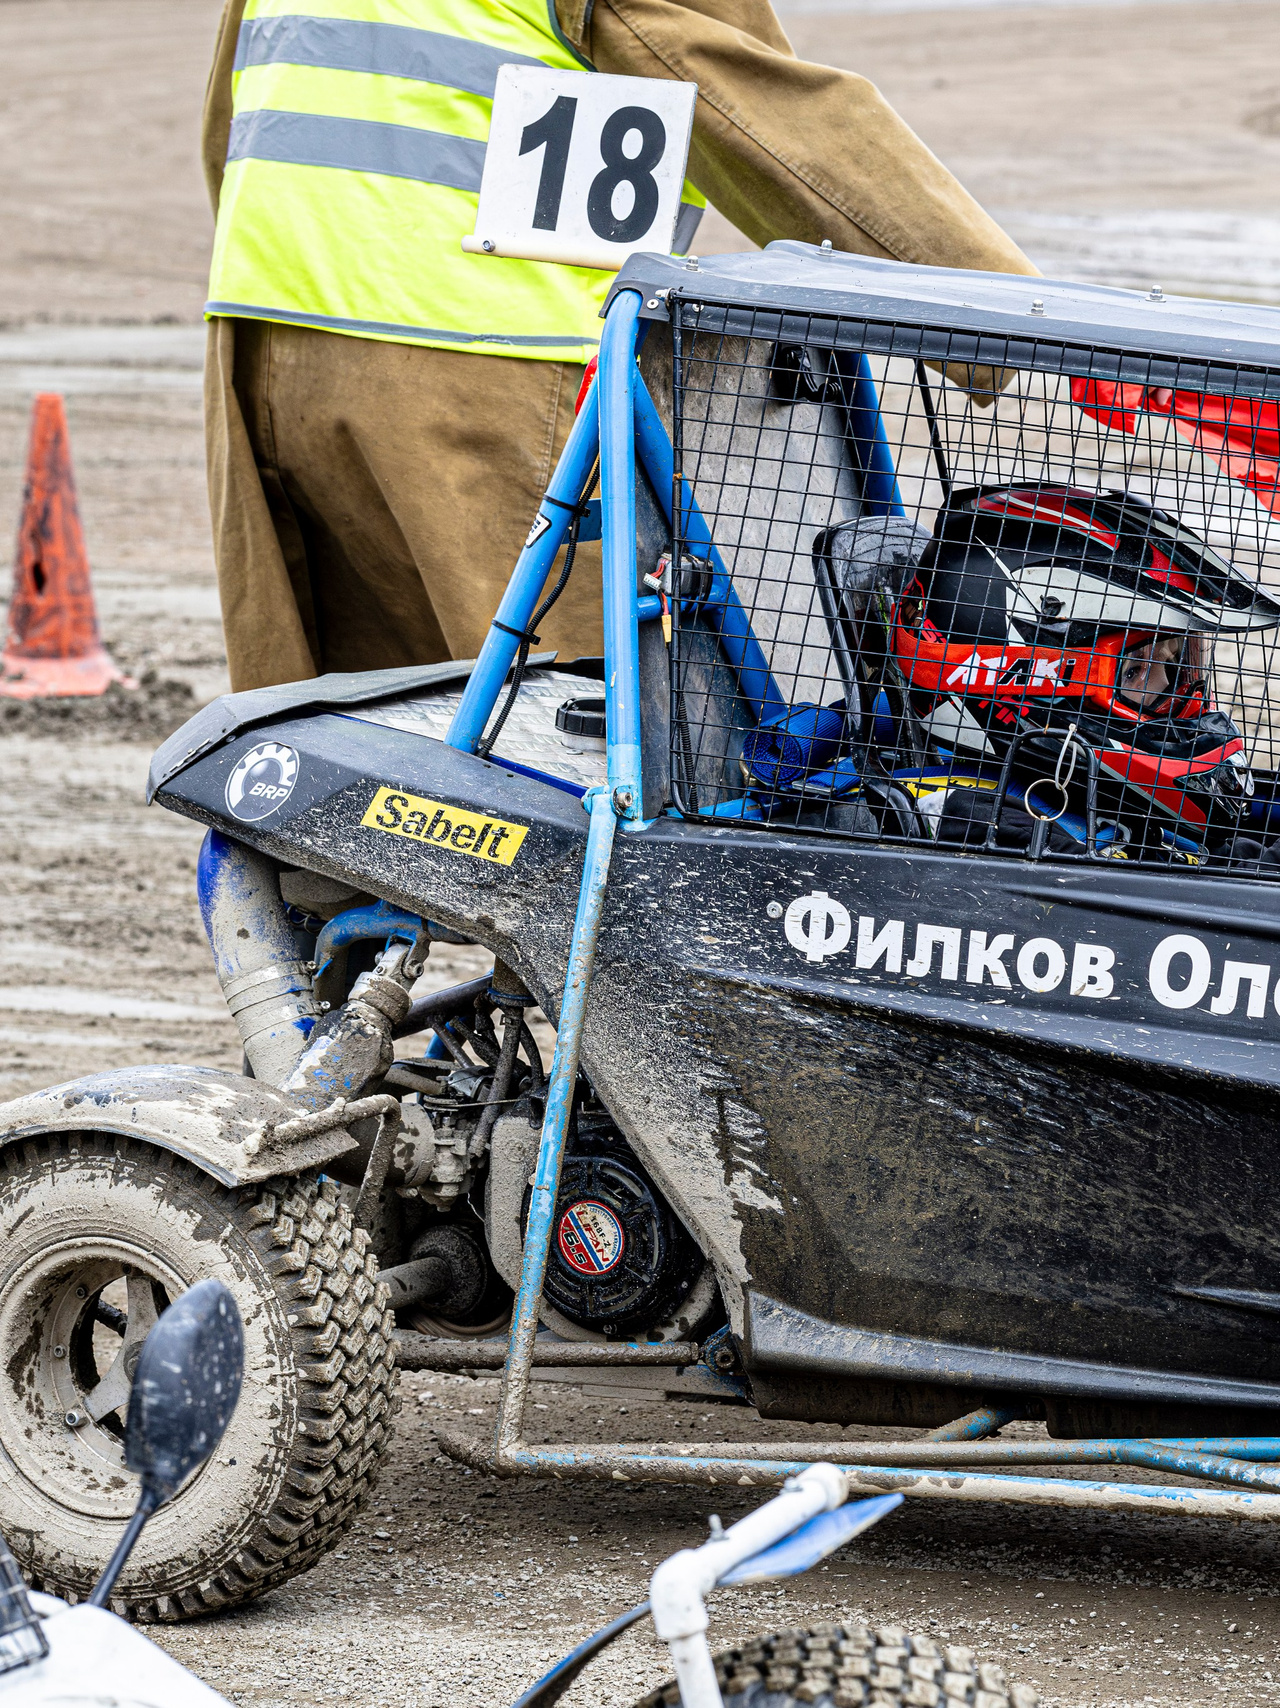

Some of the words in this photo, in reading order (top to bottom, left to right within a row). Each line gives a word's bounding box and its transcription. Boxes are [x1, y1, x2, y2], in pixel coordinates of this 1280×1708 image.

[518, 95, 666, 243] 18
[249, 782, 289, 800] BRP
[375, 794, 510, 859] Sabelt
[784, 890, 1116, 998] Филков
[562, 1230, 588, 1264] 6.5
